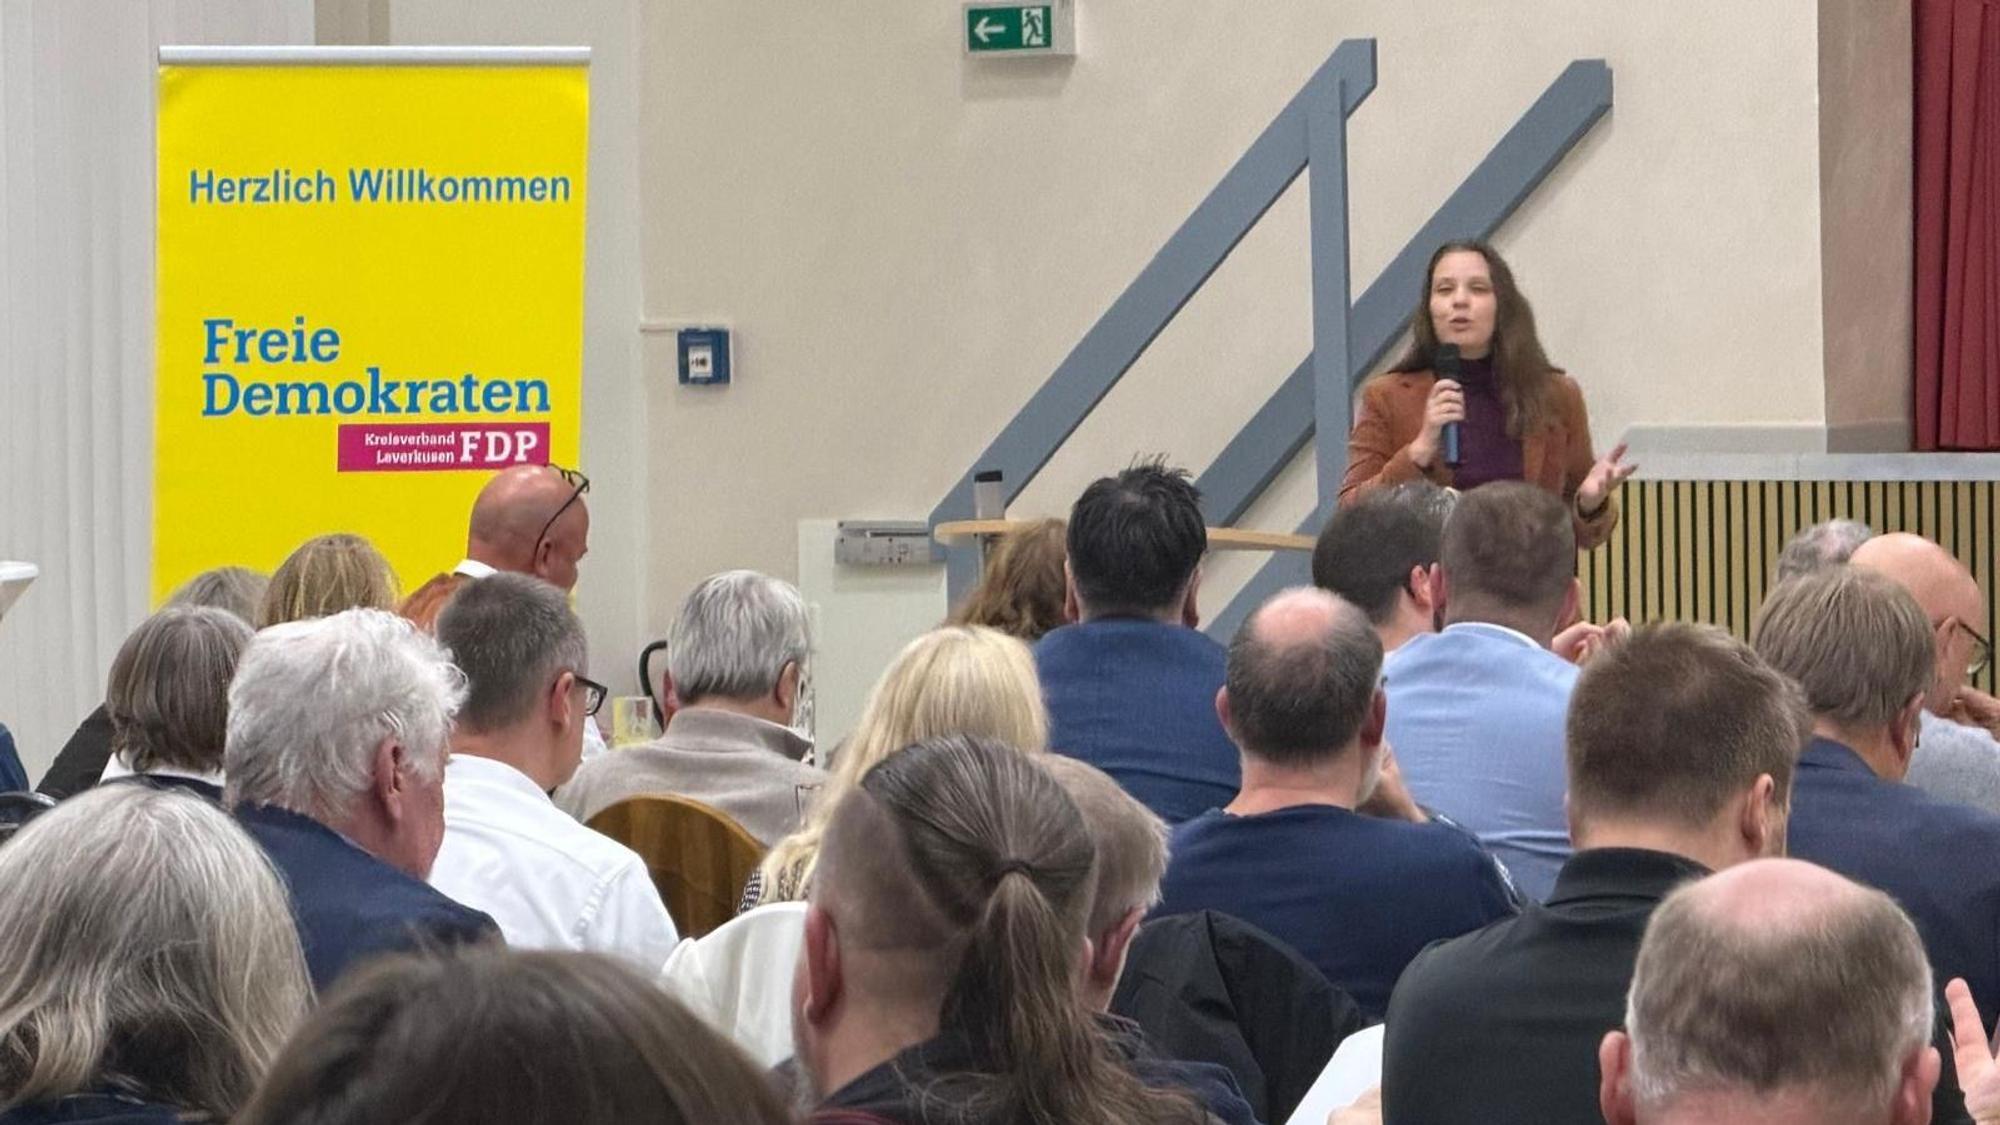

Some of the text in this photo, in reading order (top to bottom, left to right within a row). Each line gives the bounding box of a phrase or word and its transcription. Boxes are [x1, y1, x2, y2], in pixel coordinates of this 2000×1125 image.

[190, 168, 570, 203] Herzlich Willkommen
[203, 315, 341, 363] Freie
[202, 367, 551, 416] Demokraten
[365, 431, 455, 446] Kreisverband
[460, 431, 538, 463] FDP
[376, 449, 455, 465] Leverkusen
